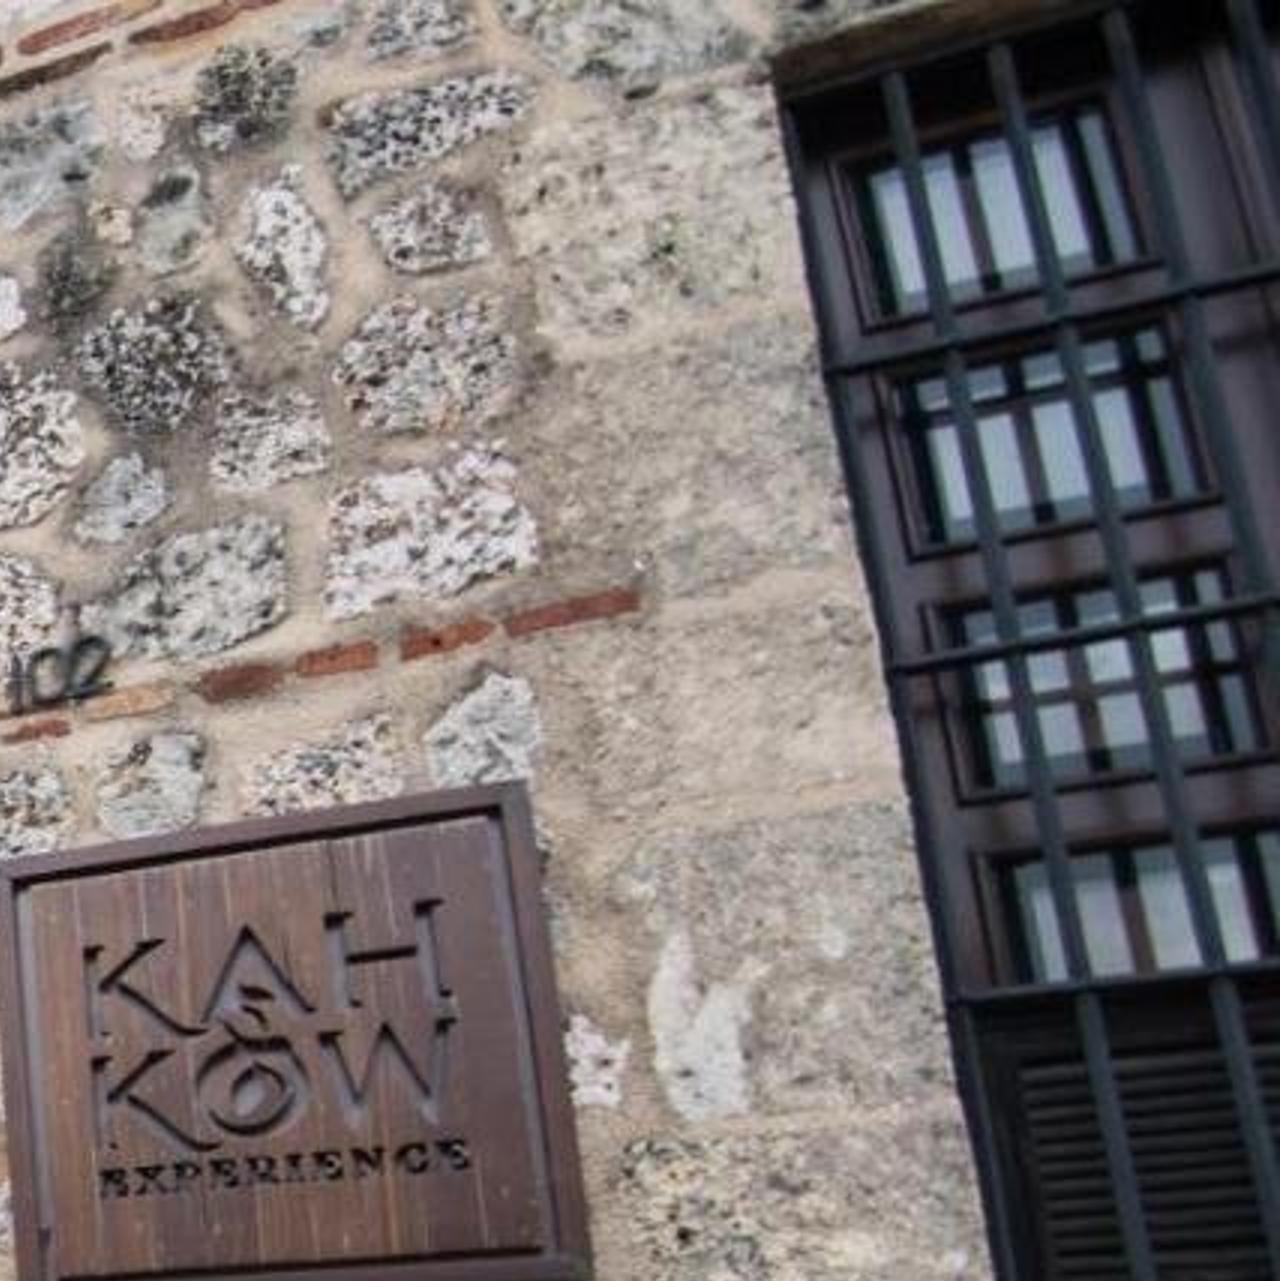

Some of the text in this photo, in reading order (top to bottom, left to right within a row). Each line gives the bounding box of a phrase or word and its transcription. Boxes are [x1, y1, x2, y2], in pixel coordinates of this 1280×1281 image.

[82, 898, 454, 1038] KAH
[90, 1016, 458, 1152] KOW
[98, 1138, 473, 1198] EXPERIENCE
